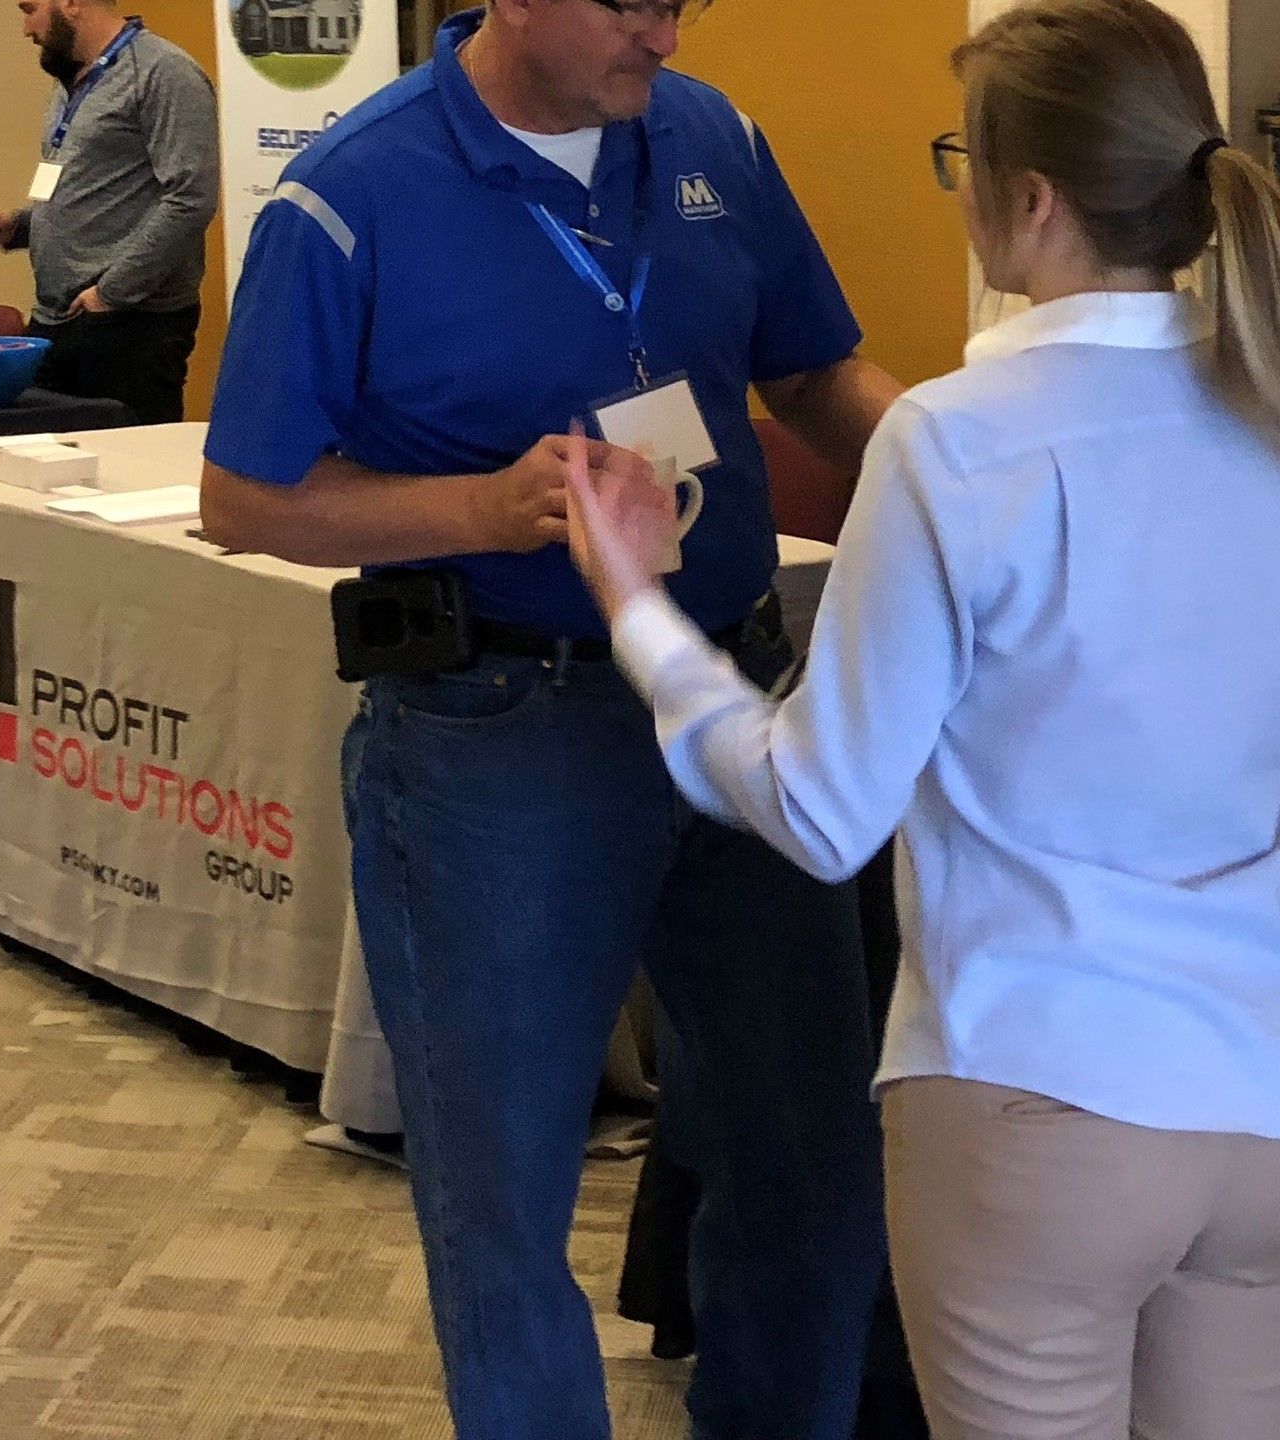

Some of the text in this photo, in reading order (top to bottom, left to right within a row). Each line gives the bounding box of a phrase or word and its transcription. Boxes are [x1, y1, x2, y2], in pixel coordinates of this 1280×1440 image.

[680, 178, 715, 206] M
[32, 668, 191, 761] PROFIT
[31, 728, 295, 860] SOLUTIONS
[204, 850, 295, 904] GROUP
